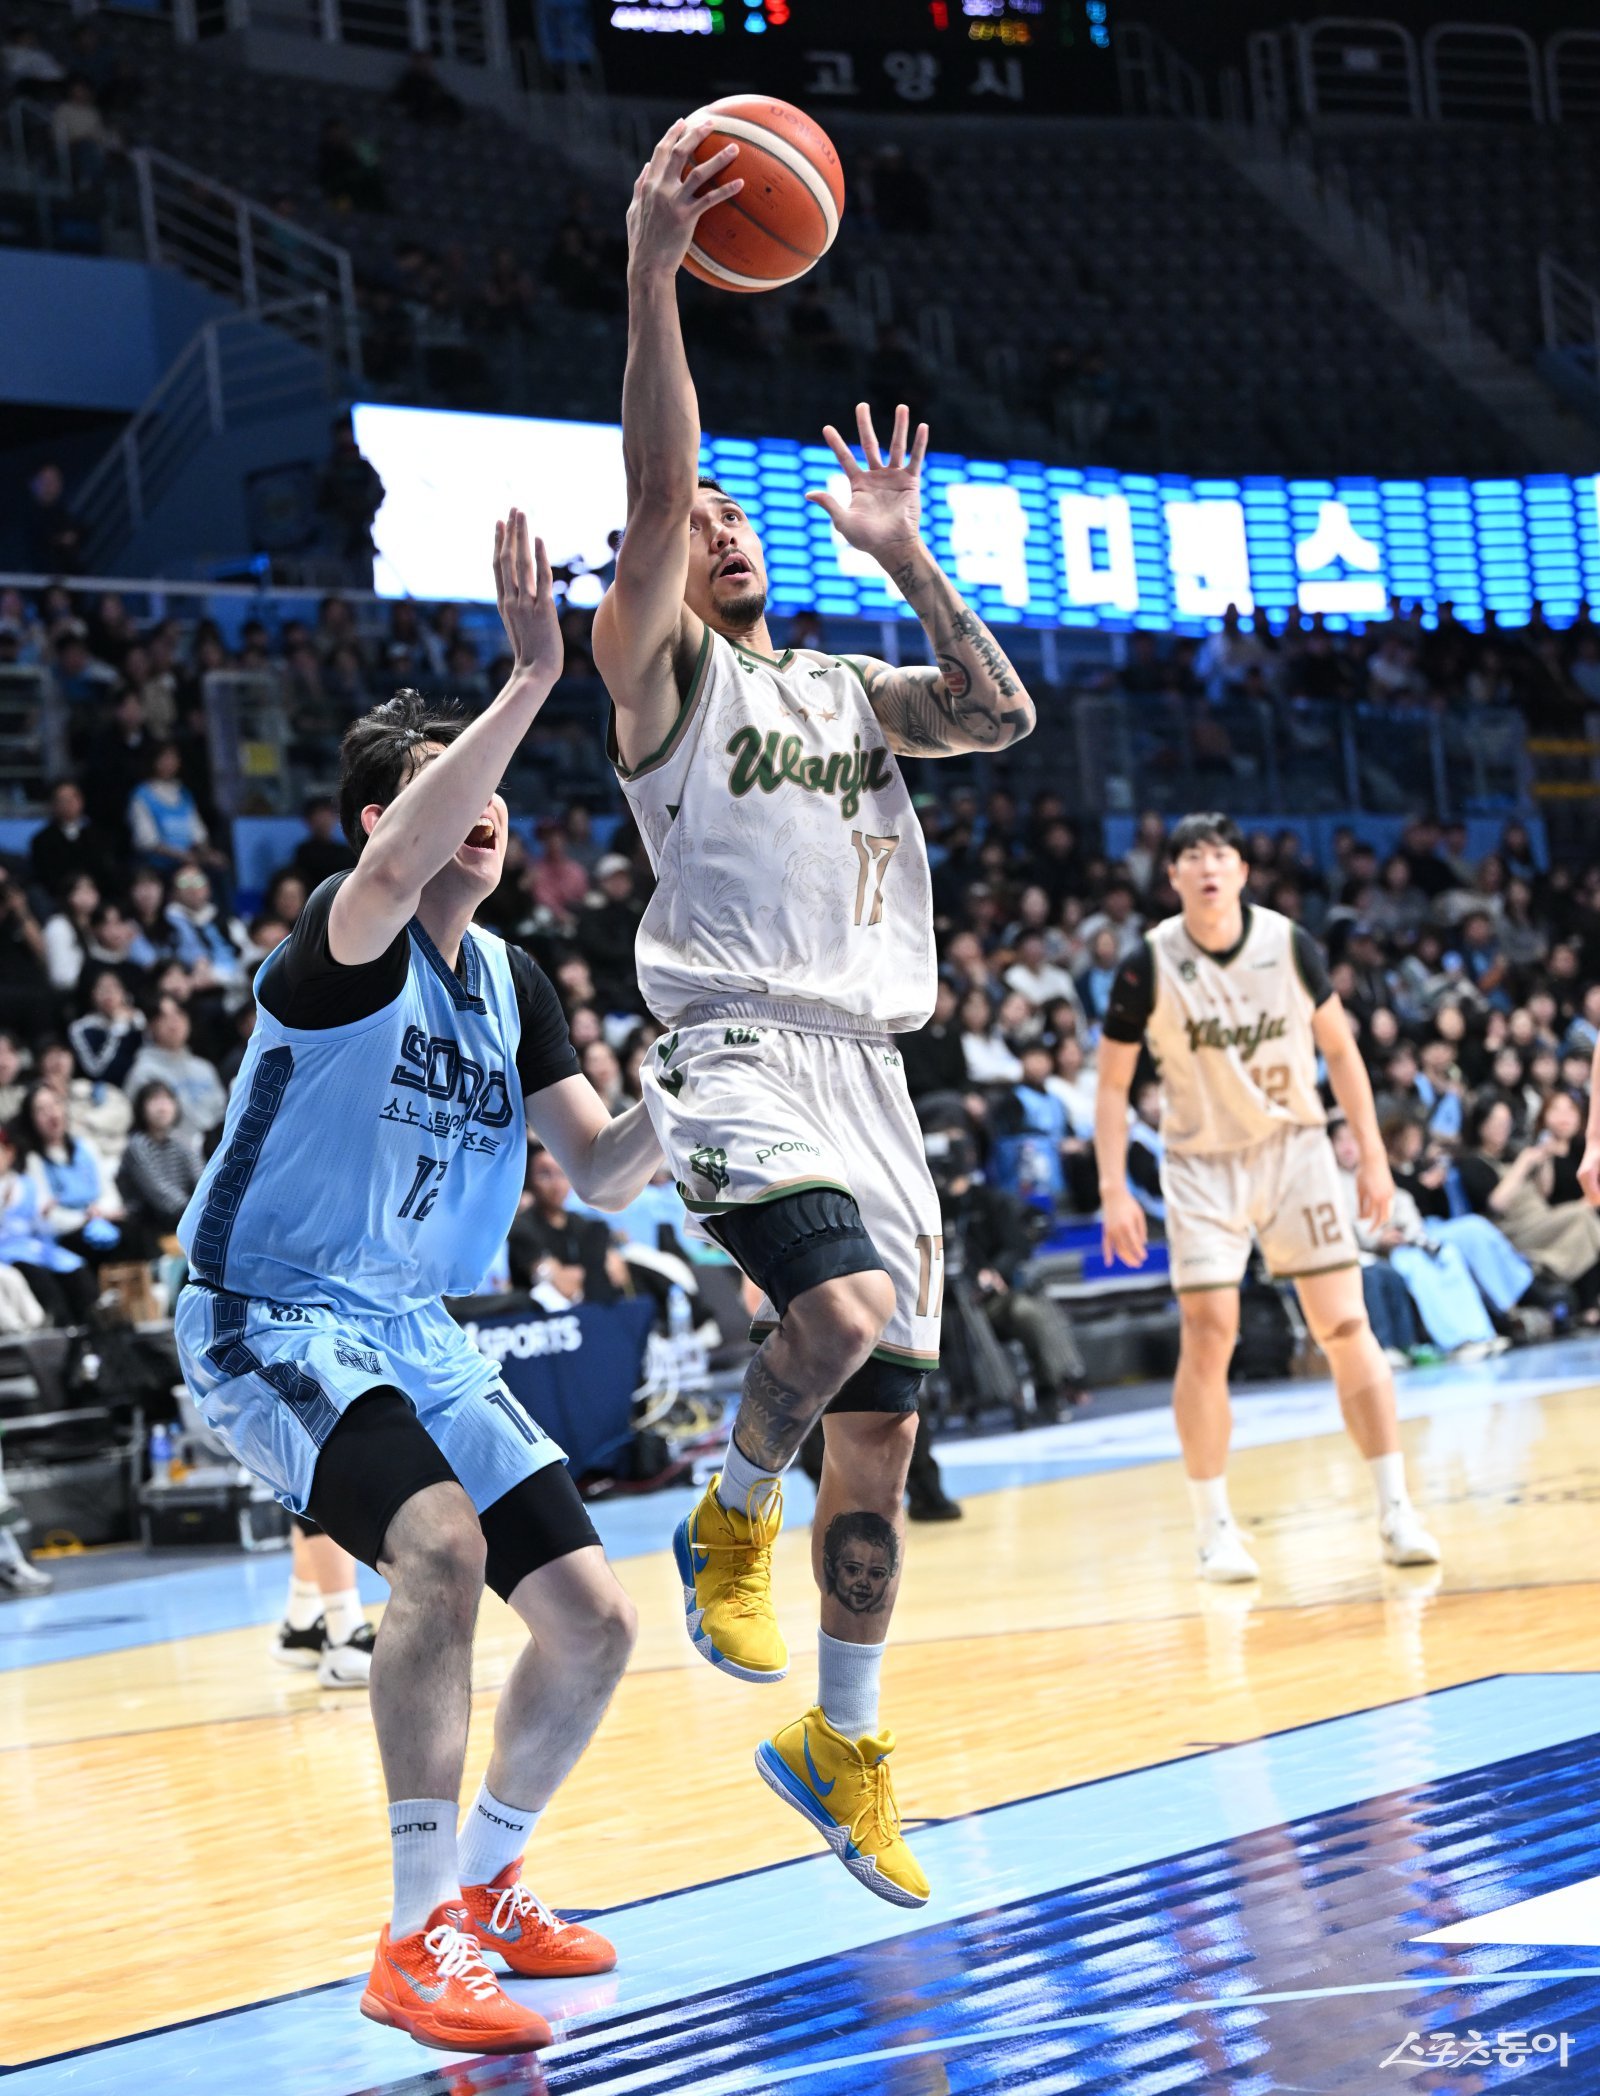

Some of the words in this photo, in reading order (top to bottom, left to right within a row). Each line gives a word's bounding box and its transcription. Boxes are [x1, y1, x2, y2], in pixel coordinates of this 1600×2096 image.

[725, 725, 893, 821] Wonju
[755, 1142, 821, 1164] promy
[1303, 1202, 1343, 1248] 12
